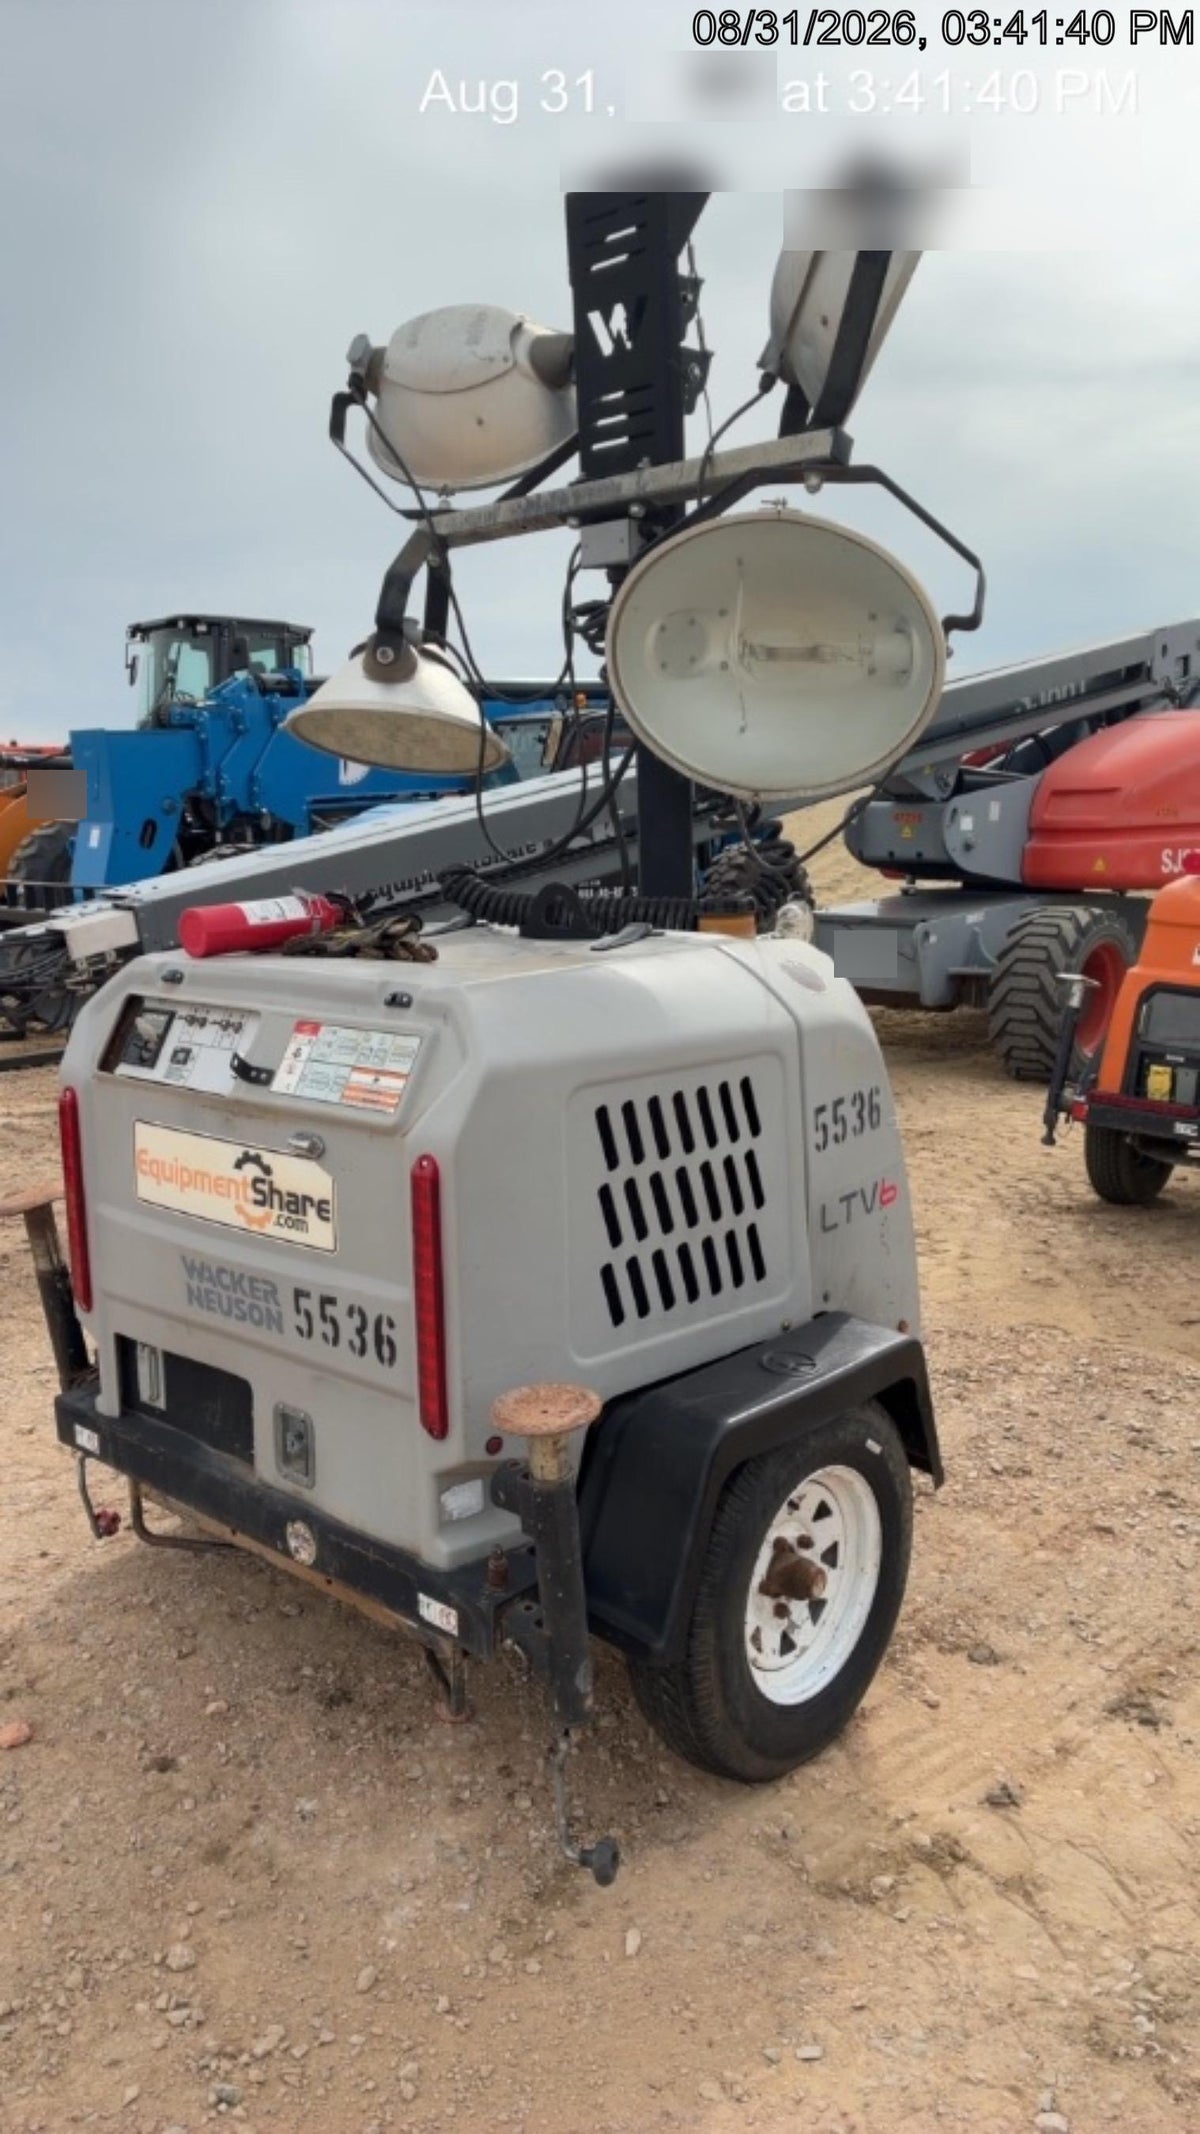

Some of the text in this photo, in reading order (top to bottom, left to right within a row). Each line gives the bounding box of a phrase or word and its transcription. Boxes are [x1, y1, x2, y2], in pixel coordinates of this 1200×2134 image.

[813, 1086, 881, 1152] 5536
[136, 1148, 331, 1222] EquipmentShare
[273, 1215, 309, 1234] .com
[181, 1256, 281, 1307] WACKER
[186, 1283, 285, 1334] NEUSON
[293, 1287, 399, 1369] 5536
